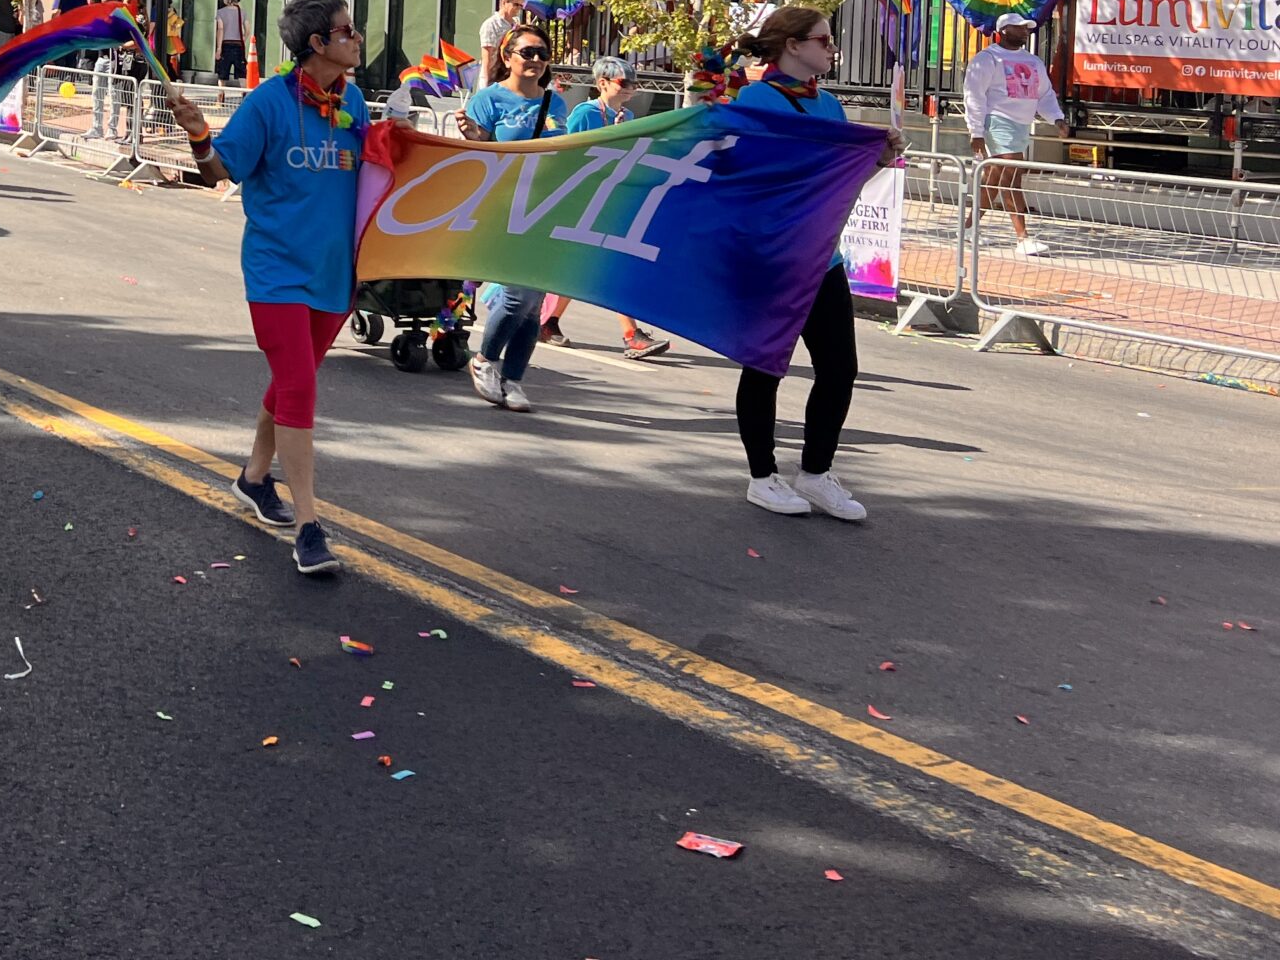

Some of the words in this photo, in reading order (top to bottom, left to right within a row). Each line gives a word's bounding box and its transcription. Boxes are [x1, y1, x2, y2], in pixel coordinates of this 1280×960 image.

[1087, 33, 1149, 46] WELLSPA
[1155, 35, 1164, 46] &
[1169, 36, 1234, 49] VITALITY
[1083, 60, 1152, 74] lumivita.com
[861, 220, 889, 232] FIRM
[843, 235, 873, 246] THAT'S
[875, 239, 889, 249] ALL
